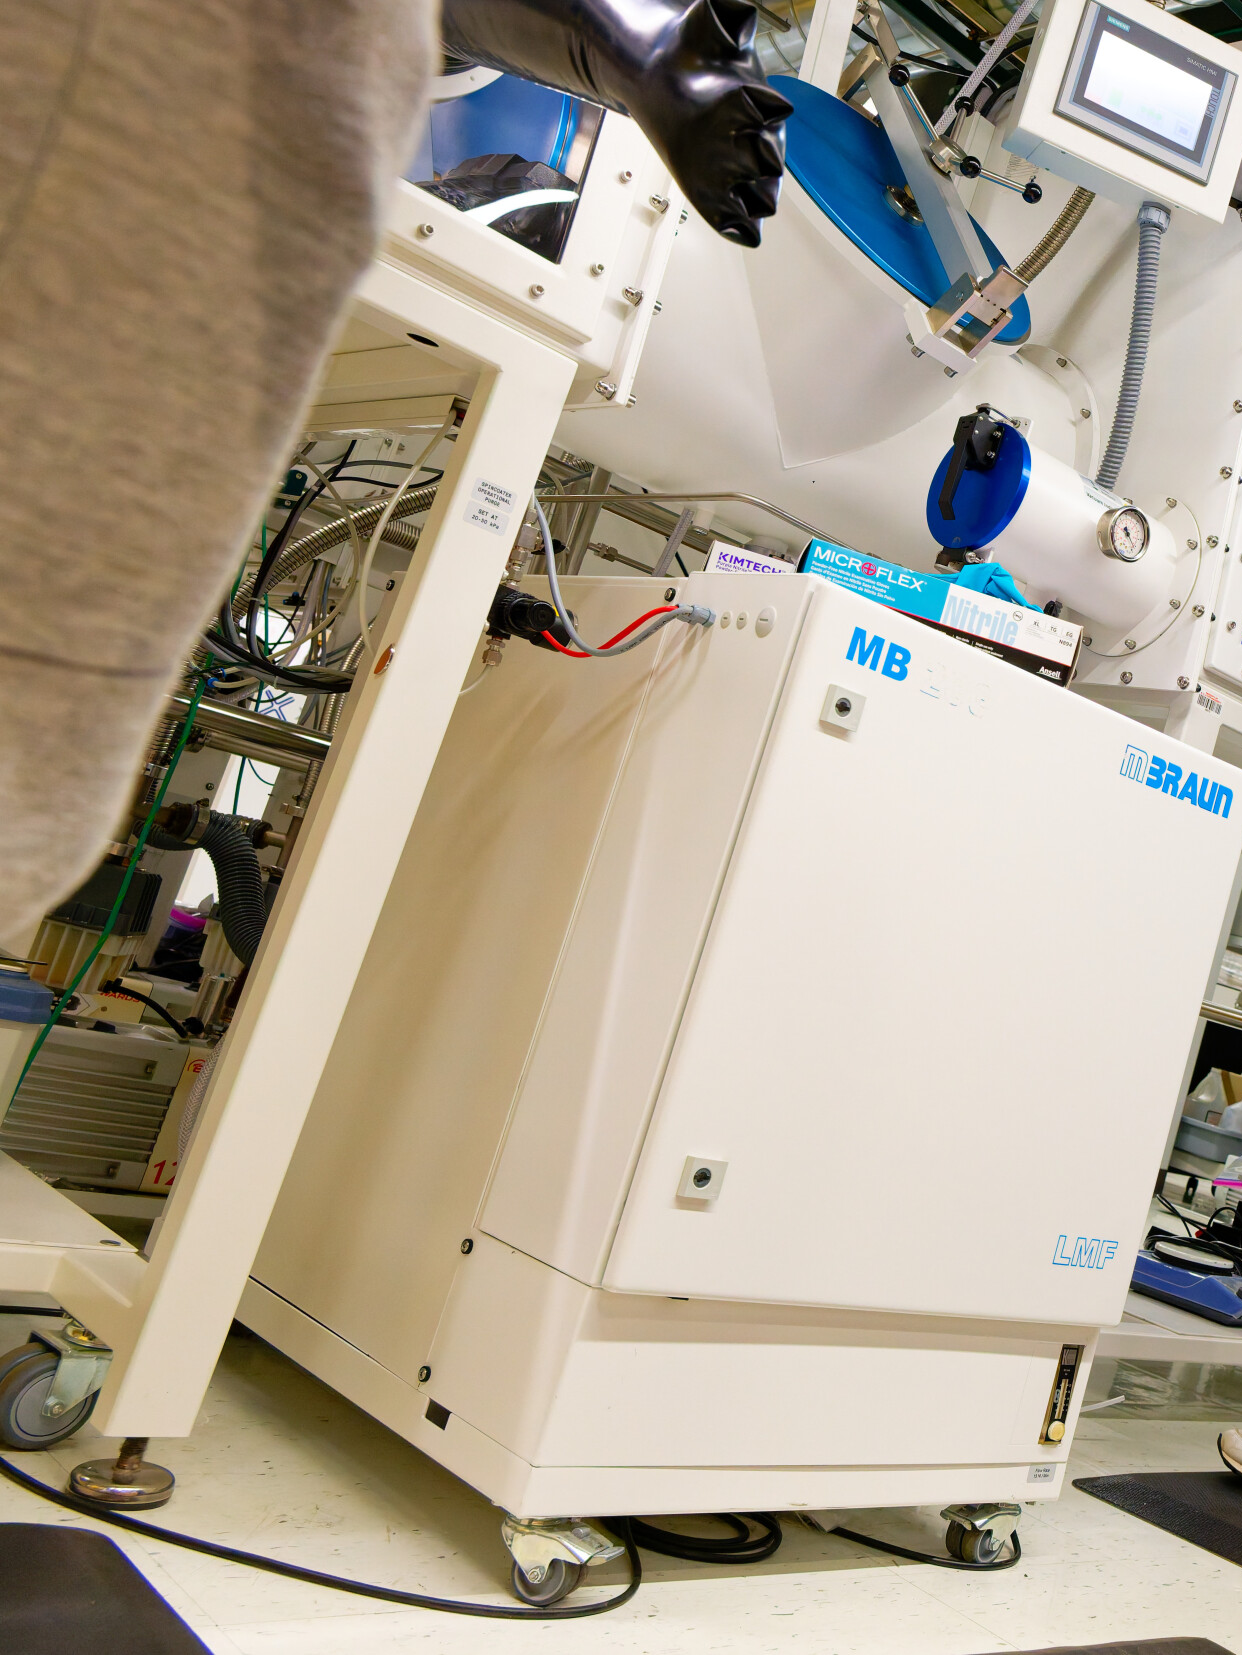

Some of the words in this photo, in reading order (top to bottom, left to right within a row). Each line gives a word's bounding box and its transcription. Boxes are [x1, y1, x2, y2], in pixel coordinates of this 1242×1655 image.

[1204, 89, 1221, 118] TOUCH
[477, 487, 511, 506] OPERATIONAL
[481, 481, 512, 499] SPINCOATER
[478, 508, 489, 516] SET
[811, 560, 838, 572] Powder-Free
[876, 581, 890, 590] Gloves
[942, 595, 1019, 647] Nitrile
[845, 626, 912, 682] MB
[1038, 666, 1061, 679] Ansell
[1052, 1234, 1119, 1270] LMF
